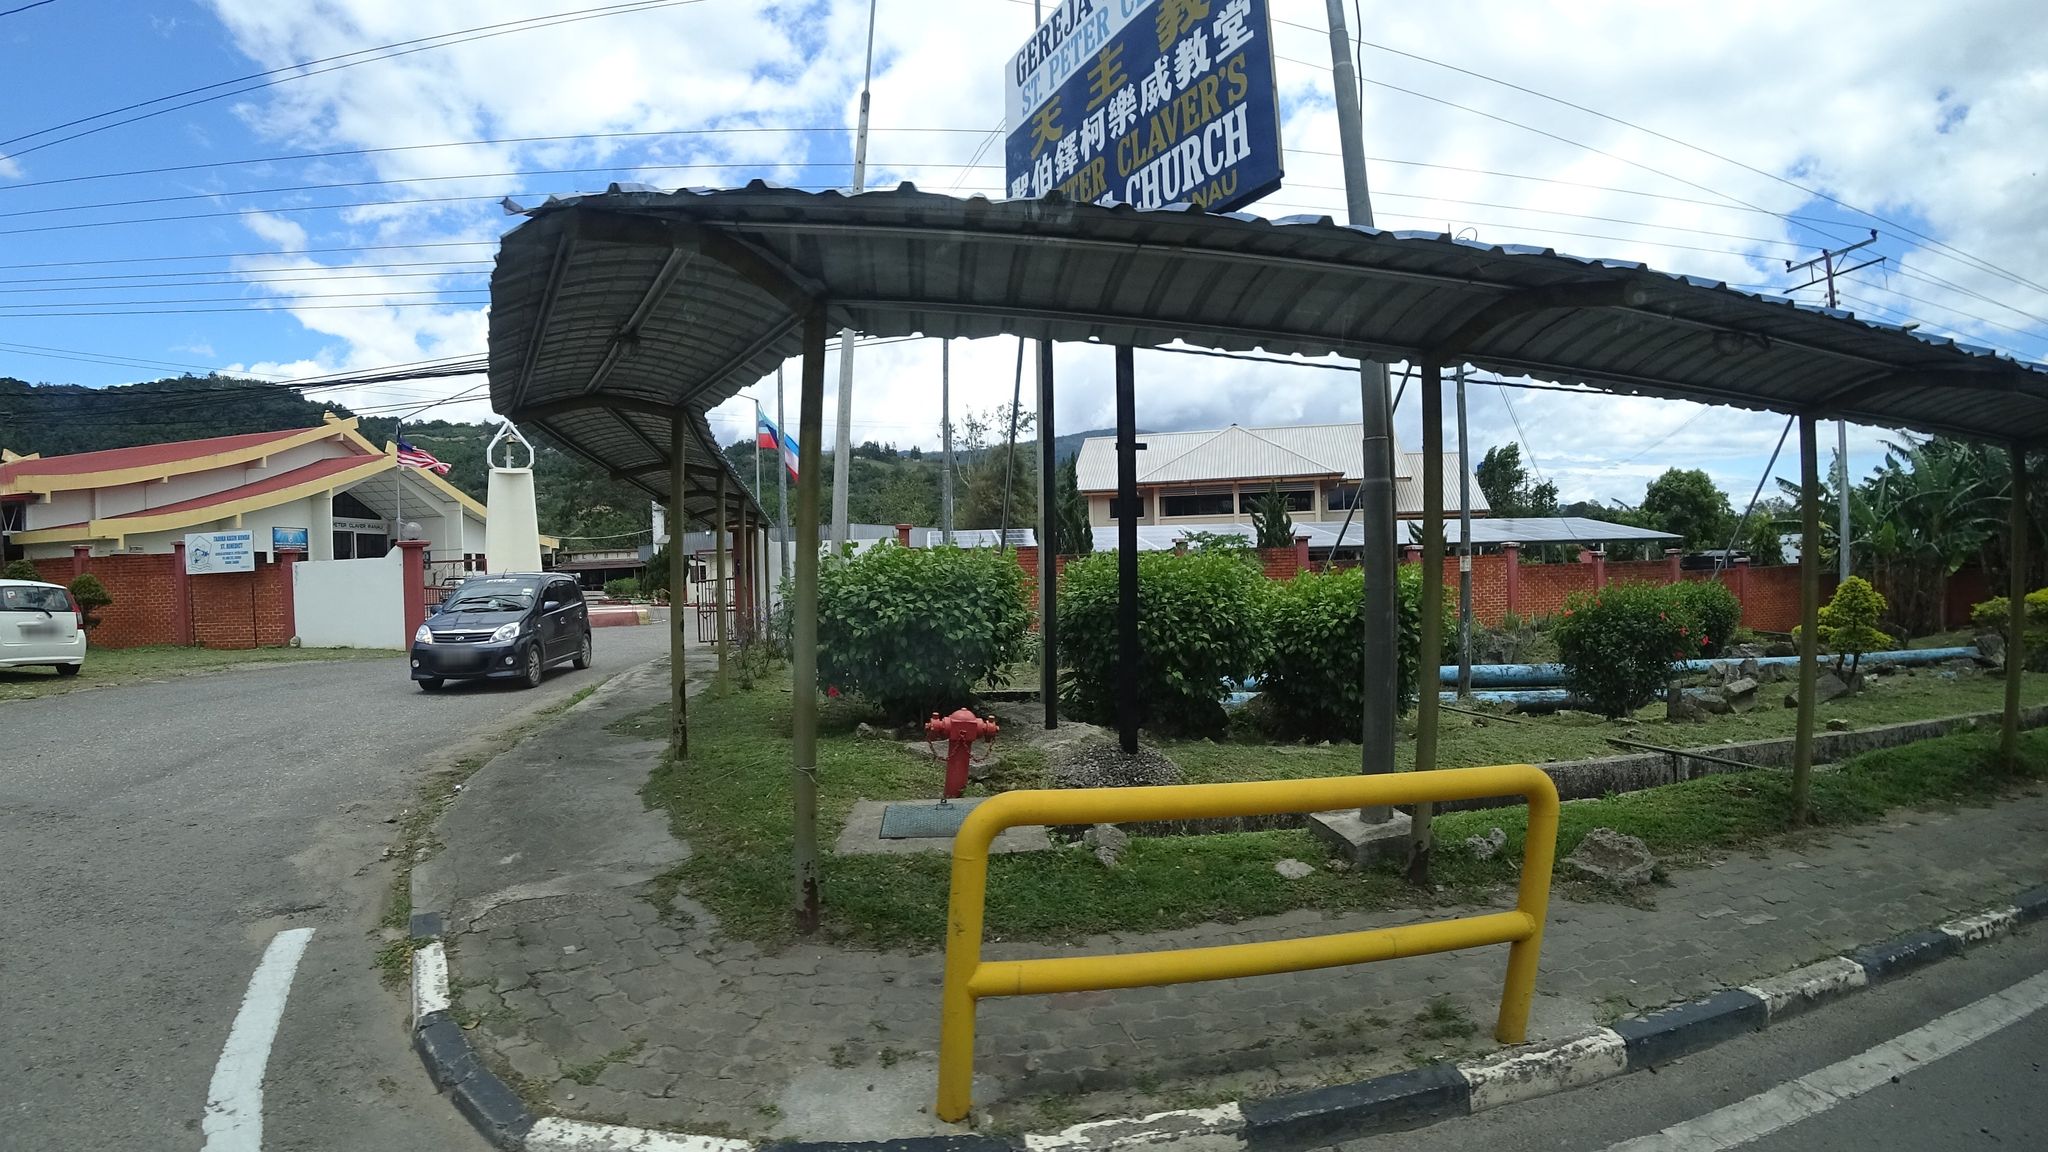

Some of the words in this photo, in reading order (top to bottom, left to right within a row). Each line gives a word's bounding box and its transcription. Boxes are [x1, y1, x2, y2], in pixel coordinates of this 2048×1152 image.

[1016, 0, 1094, 86] GEREJA
[1021, 74, 1043, 117] ST.
[1048, 6, 1110, 91] PETER
[1057, 156, 1107, 203] TER
[1117, 52, 1249, 177] CLAVER'S
[1125, 101, 1251, 209] CHURCH
[7, 591, 16, 599] P
